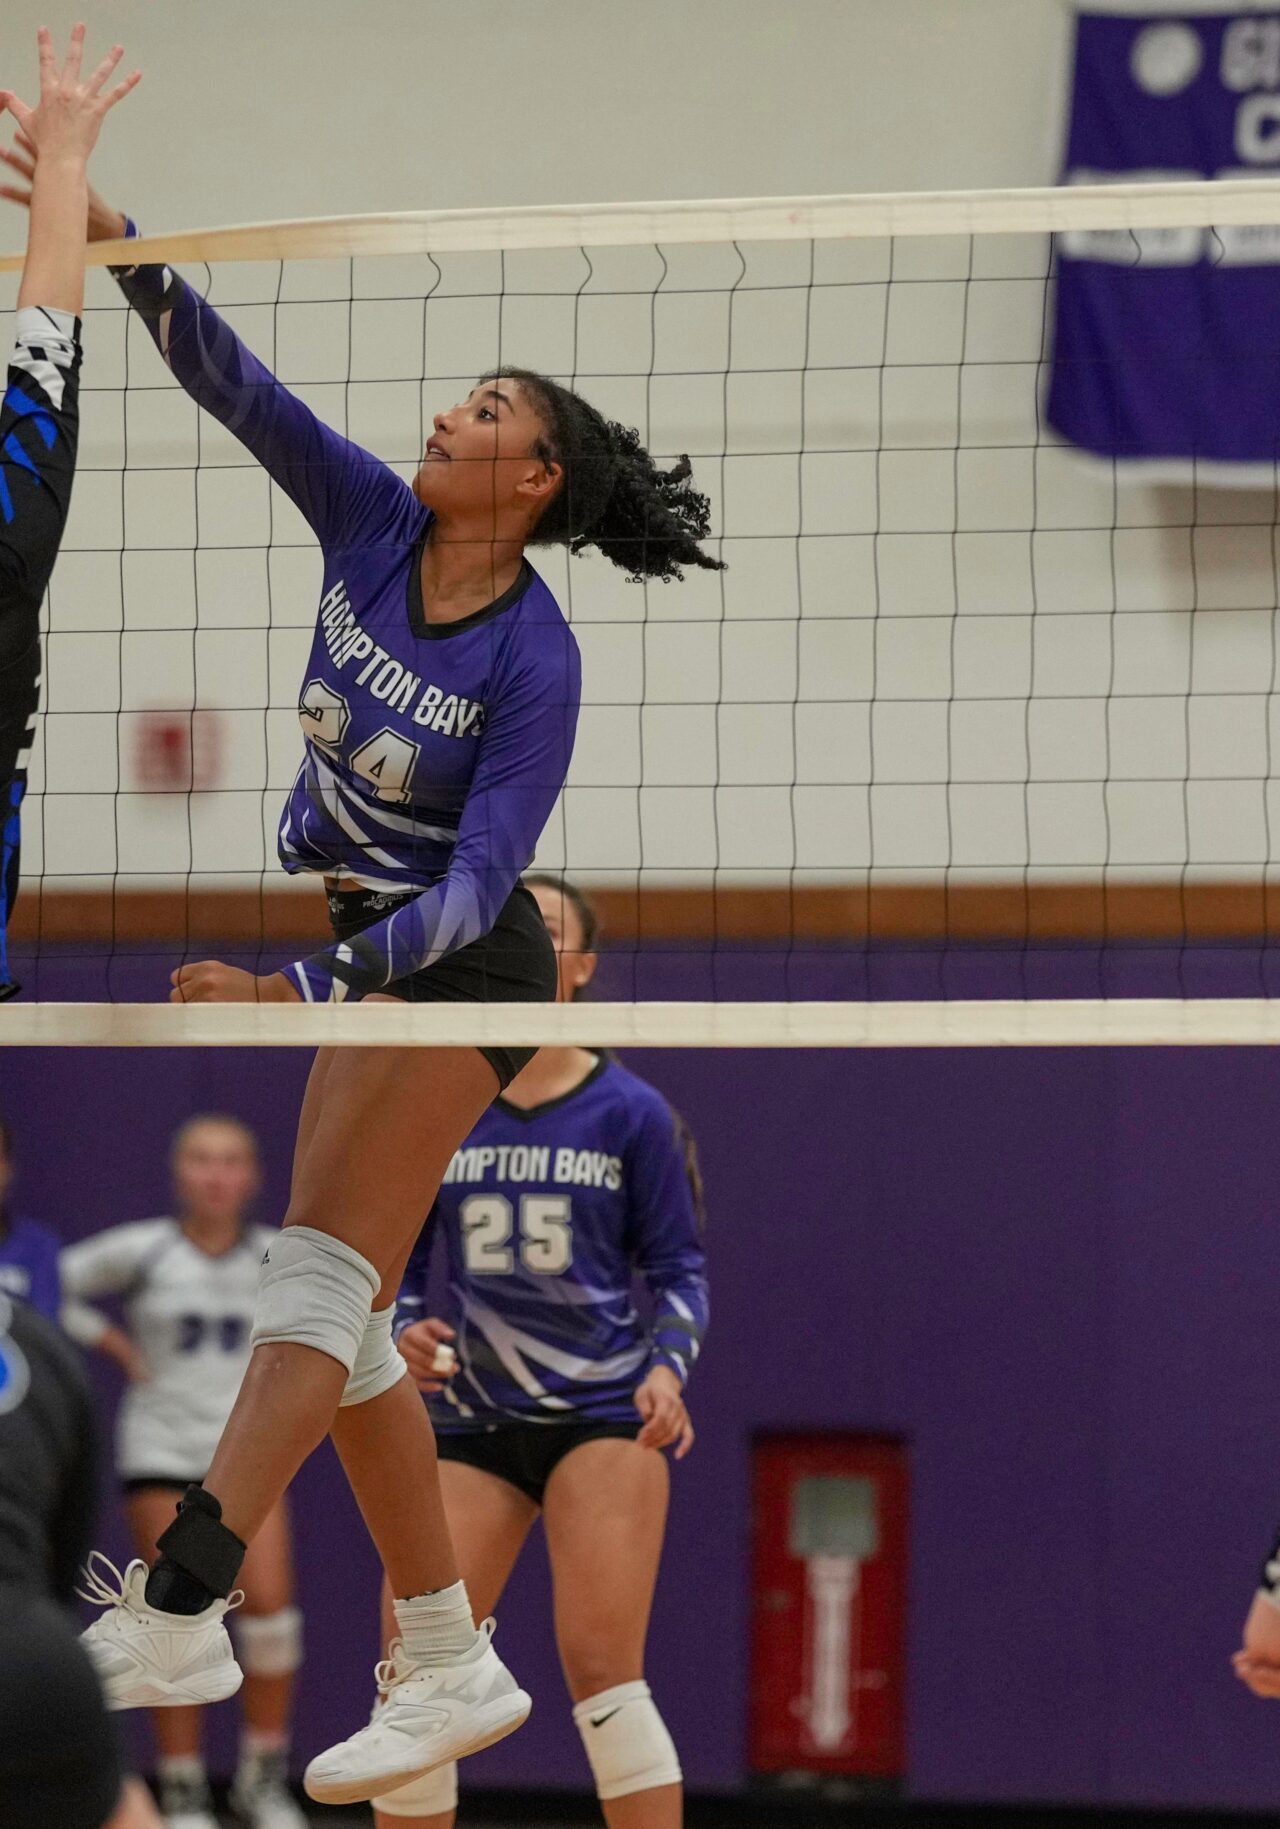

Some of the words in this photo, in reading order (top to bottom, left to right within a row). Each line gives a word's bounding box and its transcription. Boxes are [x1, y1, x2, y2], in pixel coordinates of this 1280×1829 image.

[320, 579, 422, 715] HAMPTON
[411, 683, 486, 738] BAYS
[298, 677, 423, 805] 24
[441, 1145, 549, 1185] MPTON
[553, 1146, 623, 1191] BAYS
[458, 1192, 574, 1276] 25
